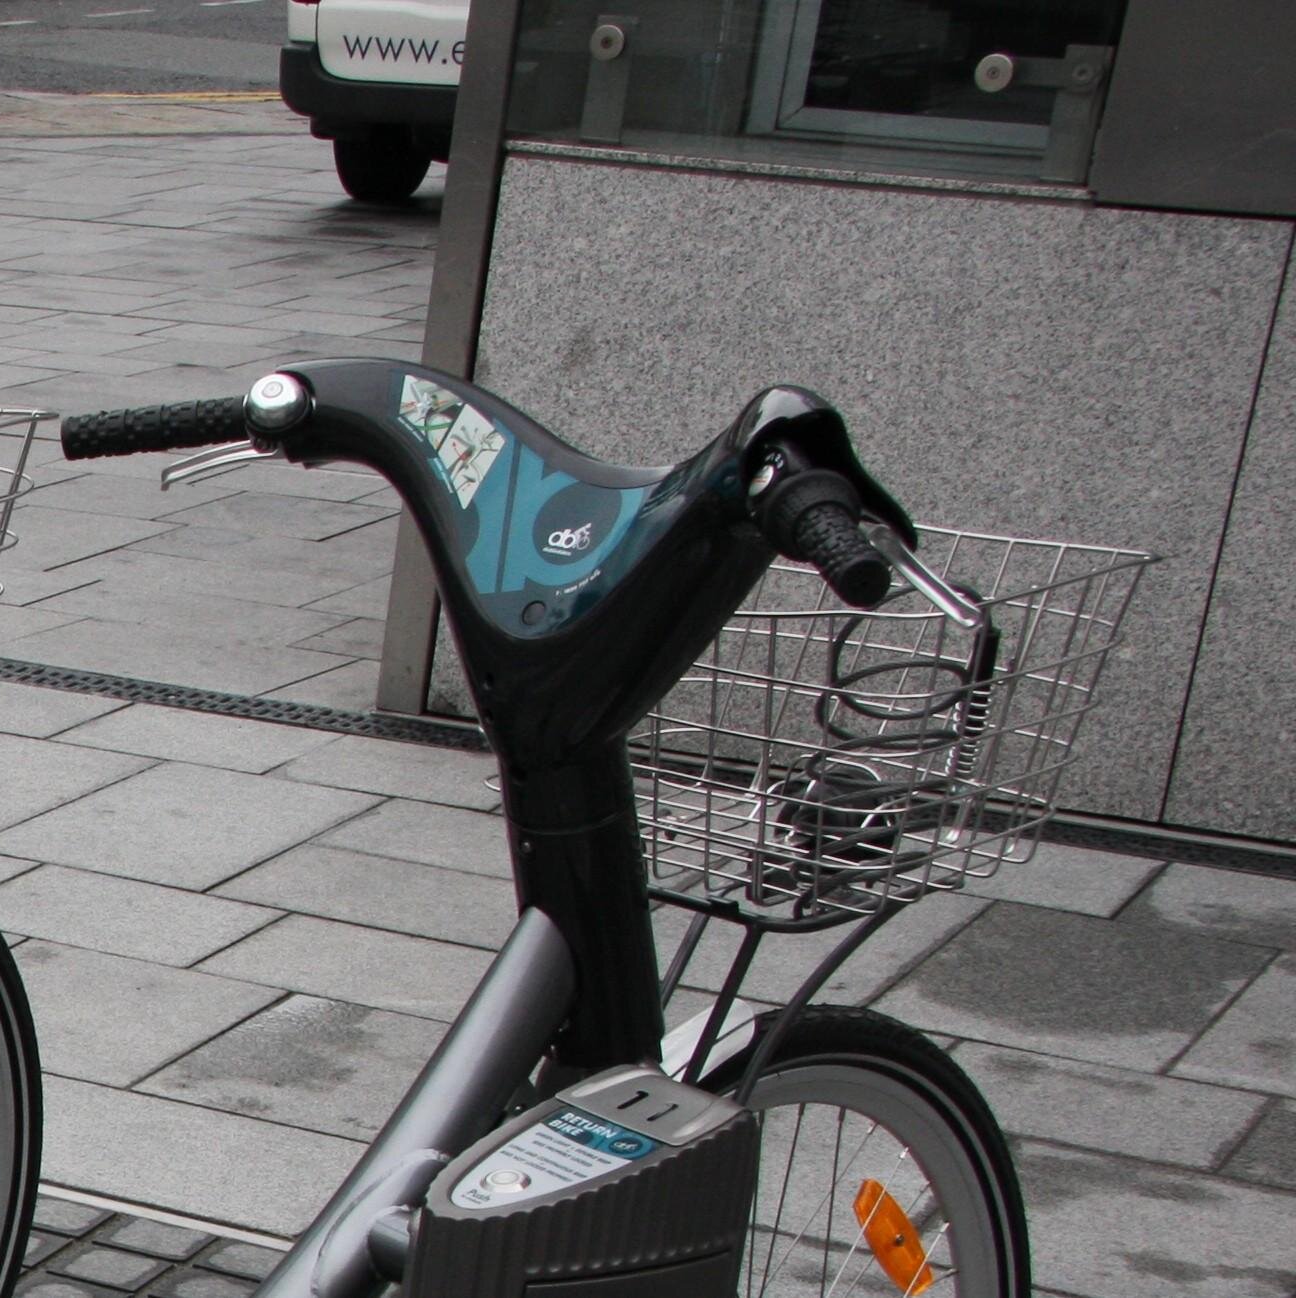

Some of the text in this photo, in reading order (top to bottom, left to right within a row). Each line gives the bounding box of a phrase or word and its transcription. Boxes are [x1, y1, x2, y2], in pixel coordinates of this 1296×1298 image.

[616, 1089, 679, 1122] 11
[548, 1119, 584, 1137] BIKE
[561, 1112, 617, 1139] RETURN
